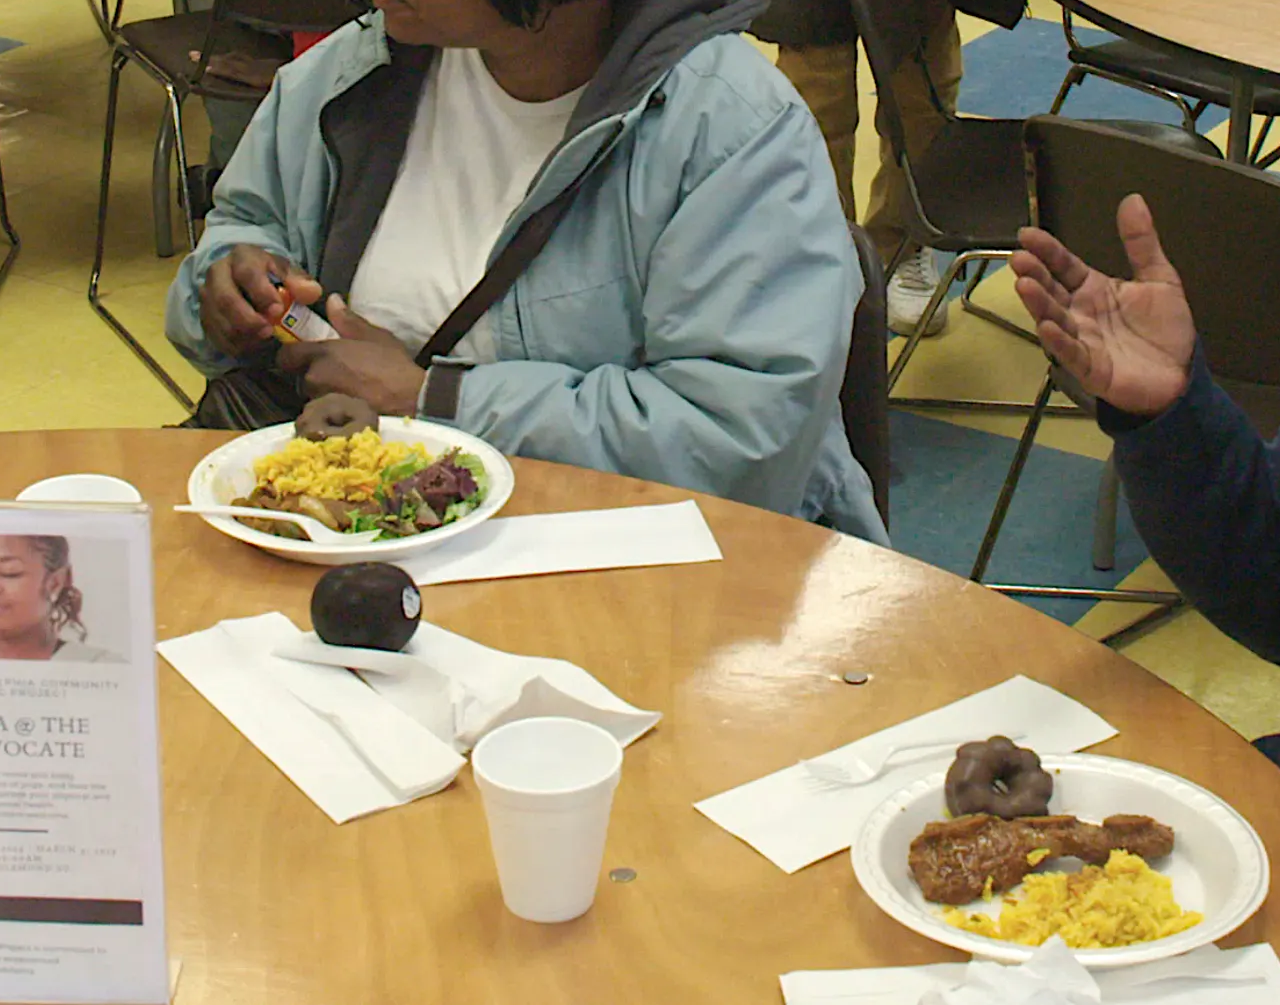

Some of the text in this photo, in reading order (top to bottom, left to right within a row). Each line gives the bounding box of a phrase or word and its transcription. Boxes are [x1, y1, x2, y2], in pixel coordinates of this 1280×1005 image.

[40, 678, 119, 691] COMMUNITY
[9, 688, 68, 698] PROJECT
[14, 717, 36, 736] @
[40, 716, 91, 735] THE
